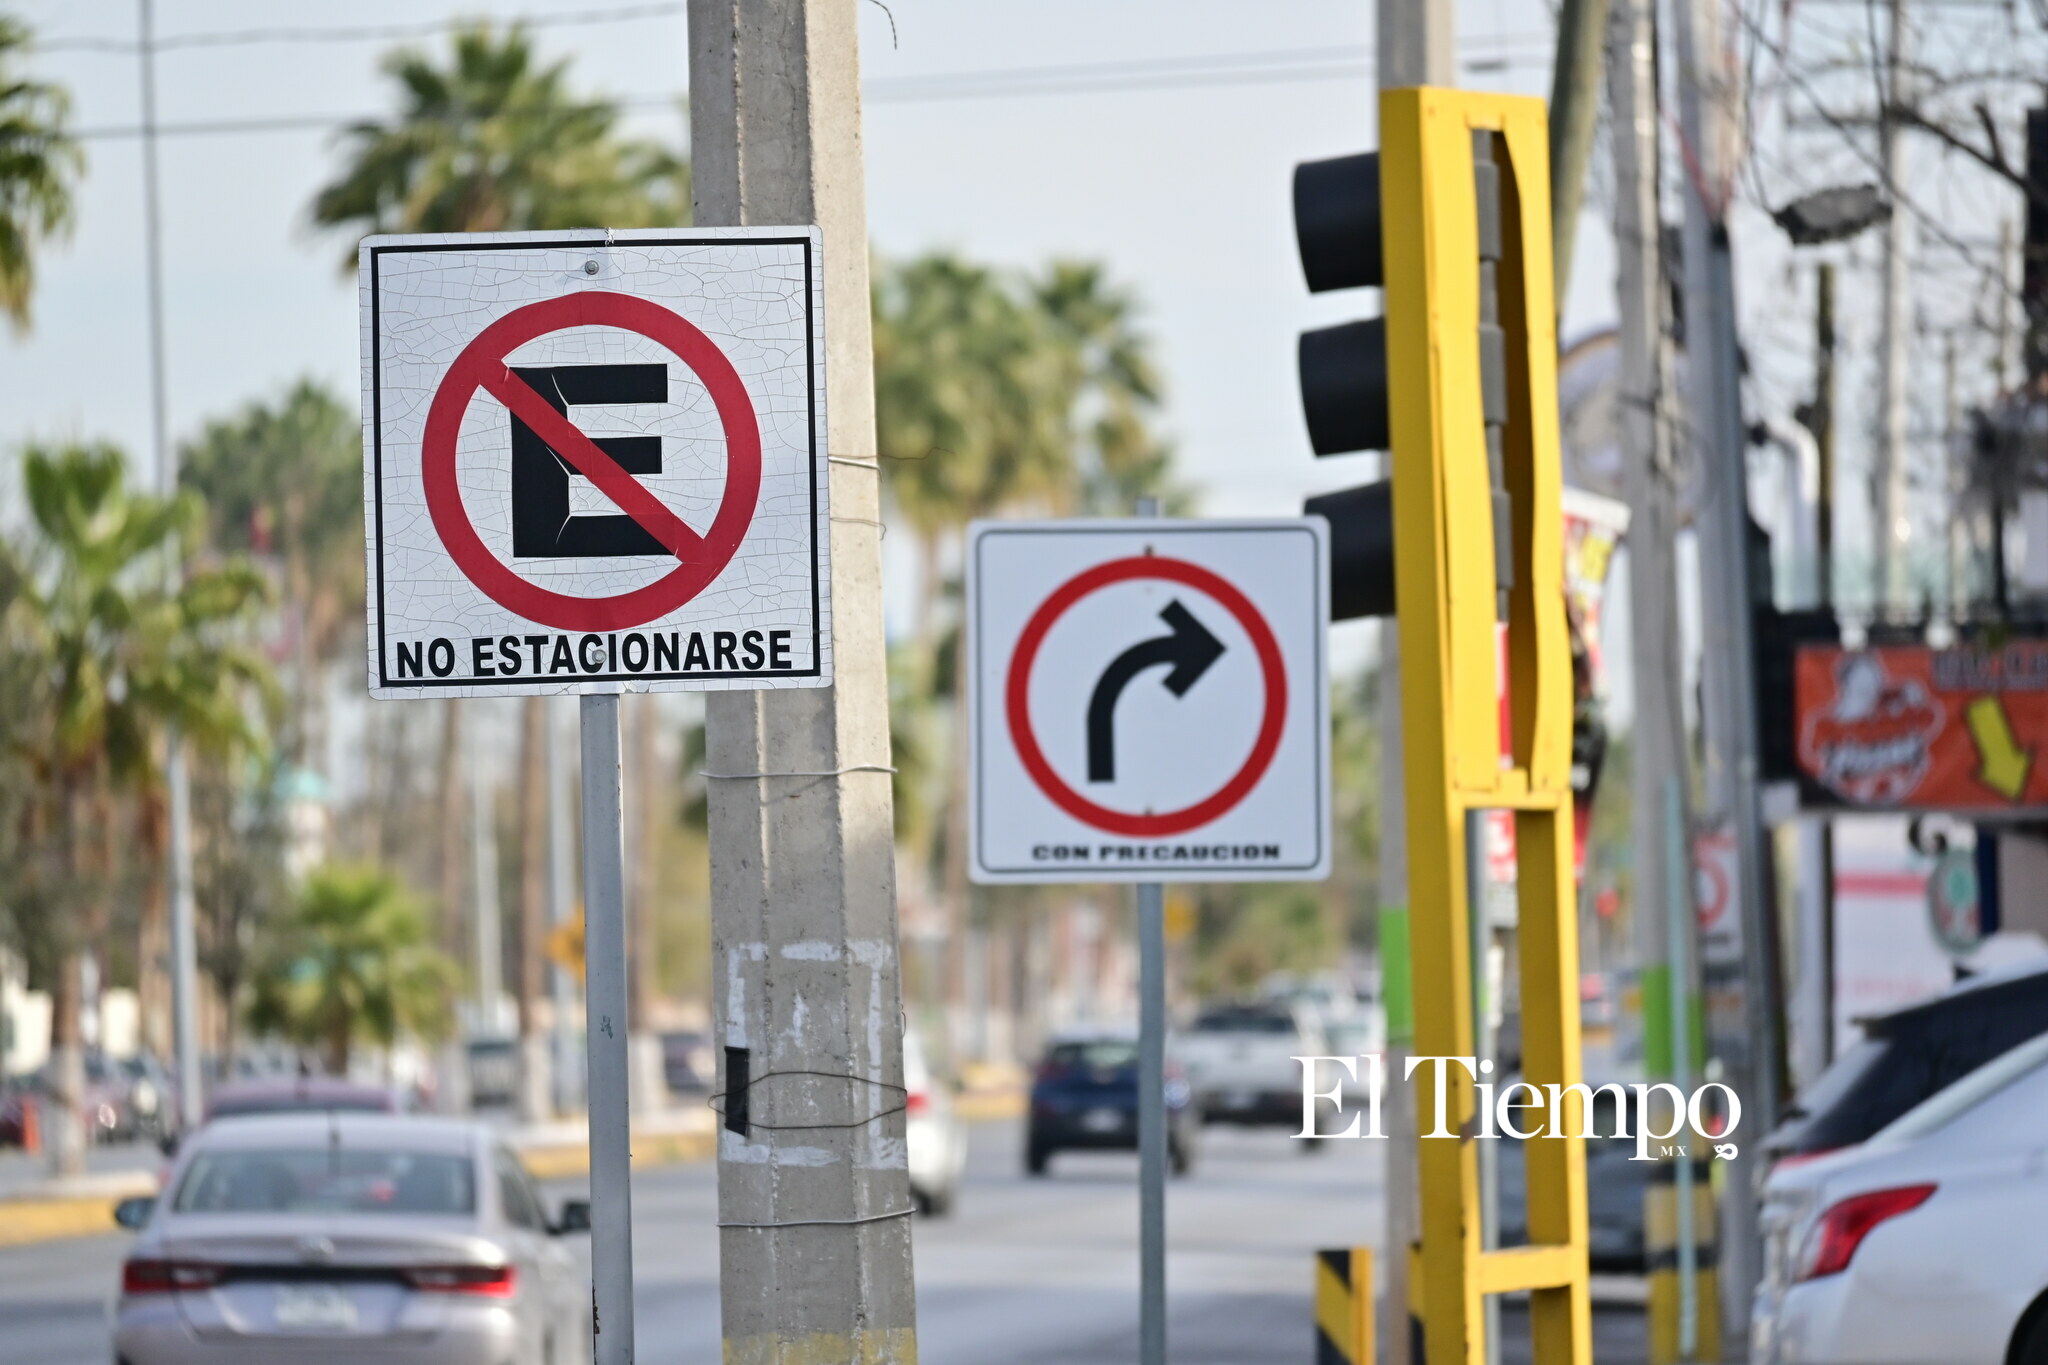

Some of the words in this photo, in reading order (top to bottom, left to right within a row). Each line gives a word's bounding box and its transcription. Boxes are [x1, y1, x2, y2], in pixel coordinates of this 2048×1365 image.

[510, 363, 677, 558] E
[396, 638, 456, 678] NO
[473, 630, 792, 676] ESTACIONARSE
[1032, 845, 1090, 860] CON
[1099, 844, 1280, 860] PRECAUCION
